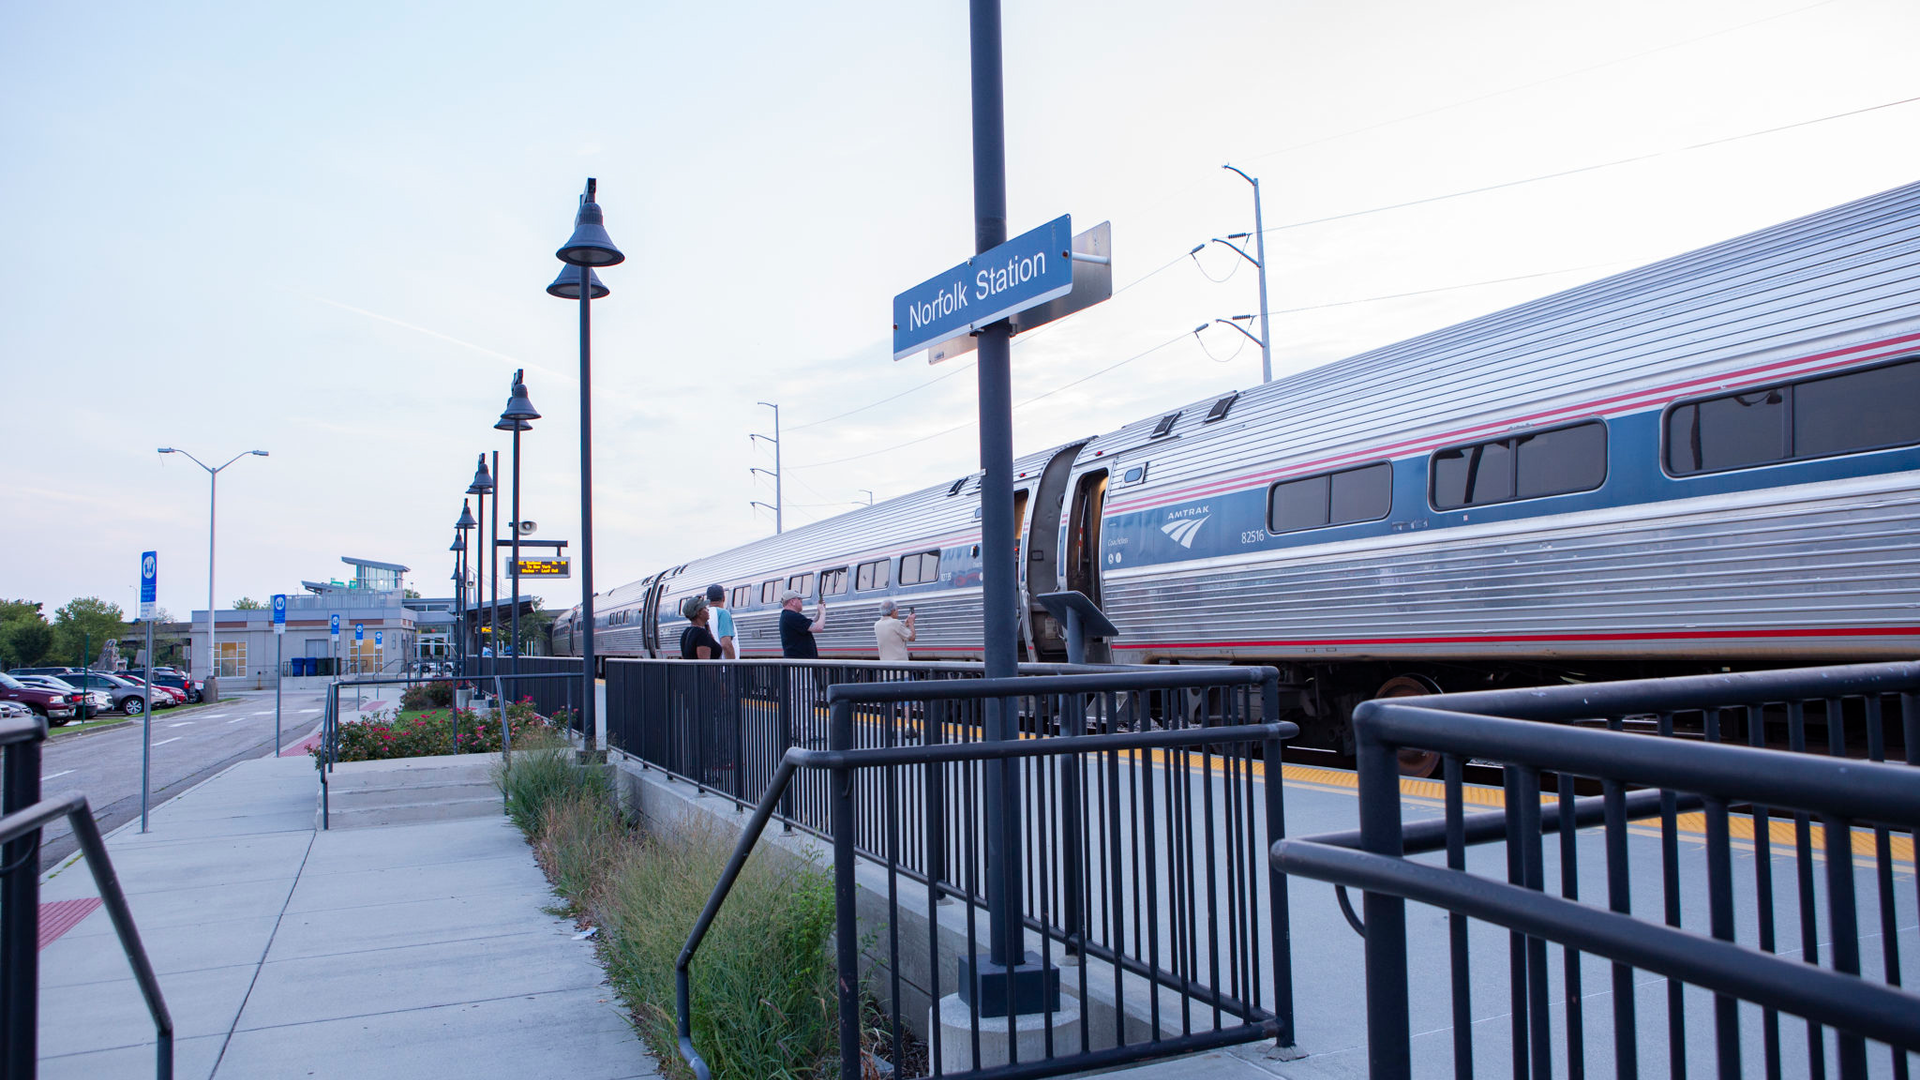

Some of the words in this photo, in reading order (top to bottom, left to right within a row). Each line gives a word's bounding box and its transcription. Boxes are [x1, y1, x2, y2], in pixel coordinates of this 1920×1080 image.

[909, 281, 968, 332] Norfolk
[975, 251, 1046, 300] Station
[1167, 505, 1210, 520] AMTRAK
[1241, 529, 1265, 544] 82516
